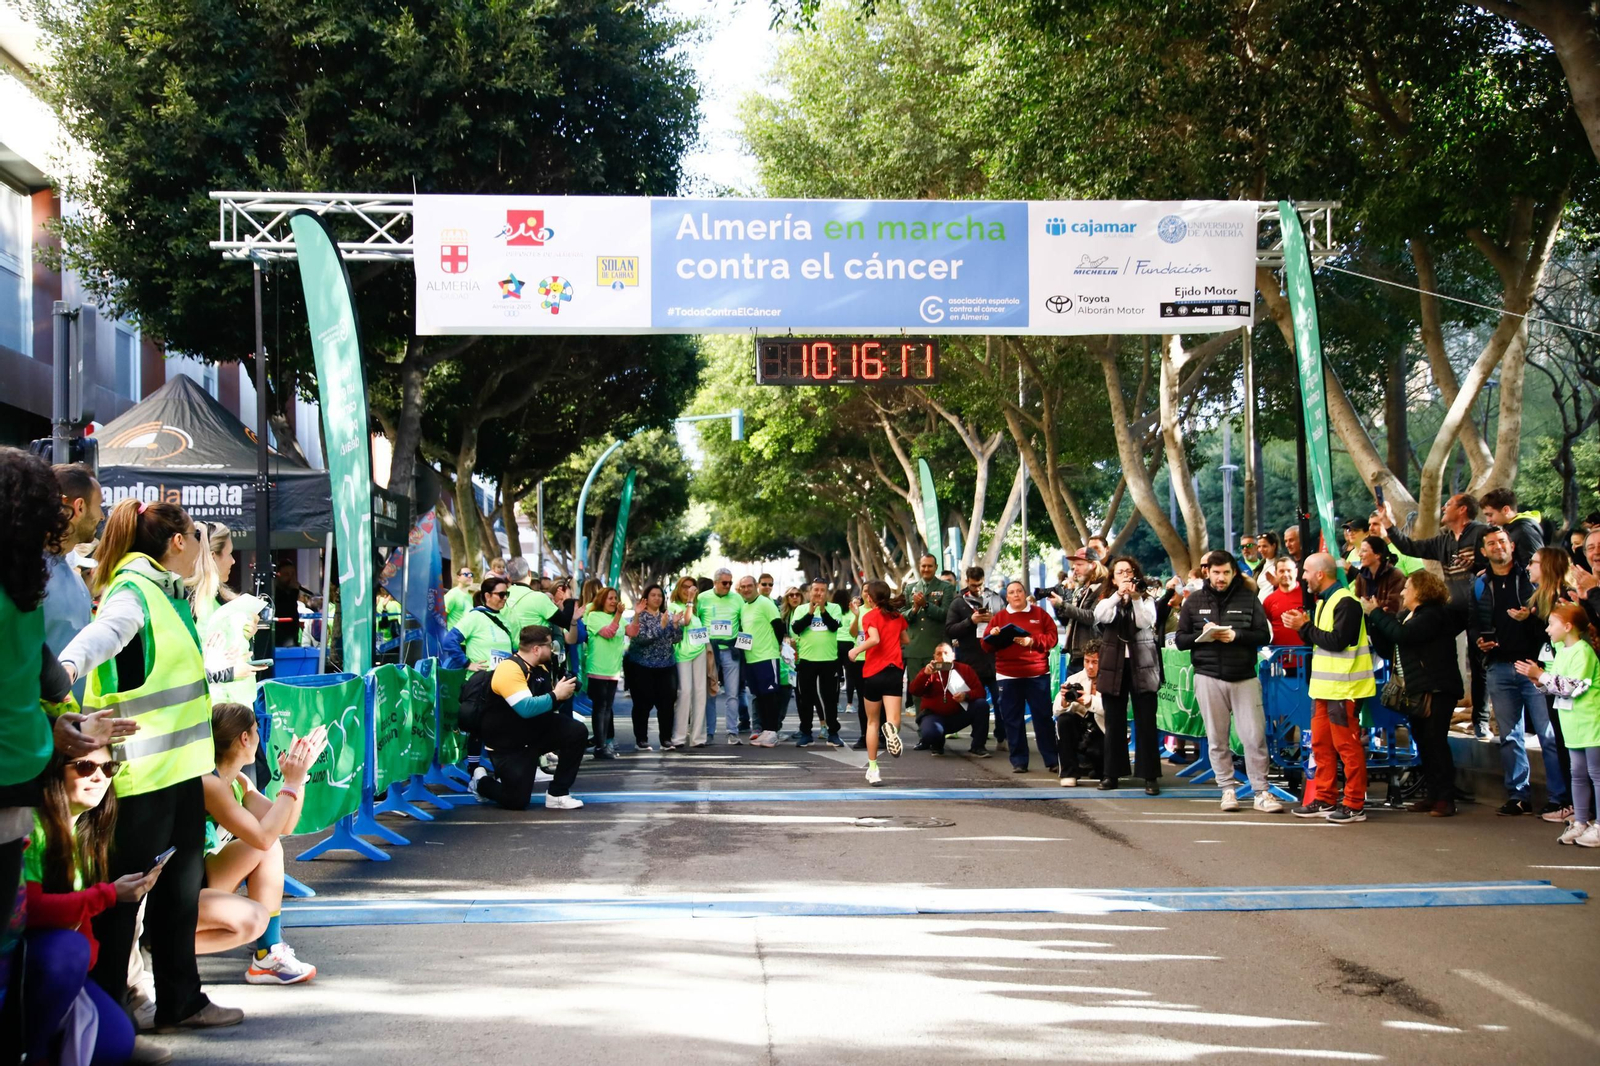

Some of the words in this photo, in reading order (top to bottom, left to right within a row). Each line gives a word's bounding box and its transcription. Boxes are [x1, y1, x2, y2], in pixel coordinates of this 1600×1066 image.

[676, 212, 812, 240] Almería
[824, 220, 864, 240] en
[878, 214, 1006, 242] marcha
[1071, 219, 1137, 236] cajamar
[602, 259, 634, 271] SOLAN
[676, 253, 790, 280] contra
[801, 252, 834, 280] el
[844, 252, 963, 280] cáncer
[1135, 260, 1212, 275] Fundación
[426, 280, 480, 290] ALMERÍA
[1174, 286, 1201, 298] Ejido
[1204, 286, 1238, 296] Motor
[988, 297, 1020, 306] española
[1078, 294, 1110, 304] Toyota
[668, 307, 782, 316] #TodosContraElCáncer
[1078, 306, 1114, 314] Alborán
[1117, 306, 1144, 314] Motor
[1212, 306, 1224, 315] FIAT
[188, 507, 242, 516] deportivo
